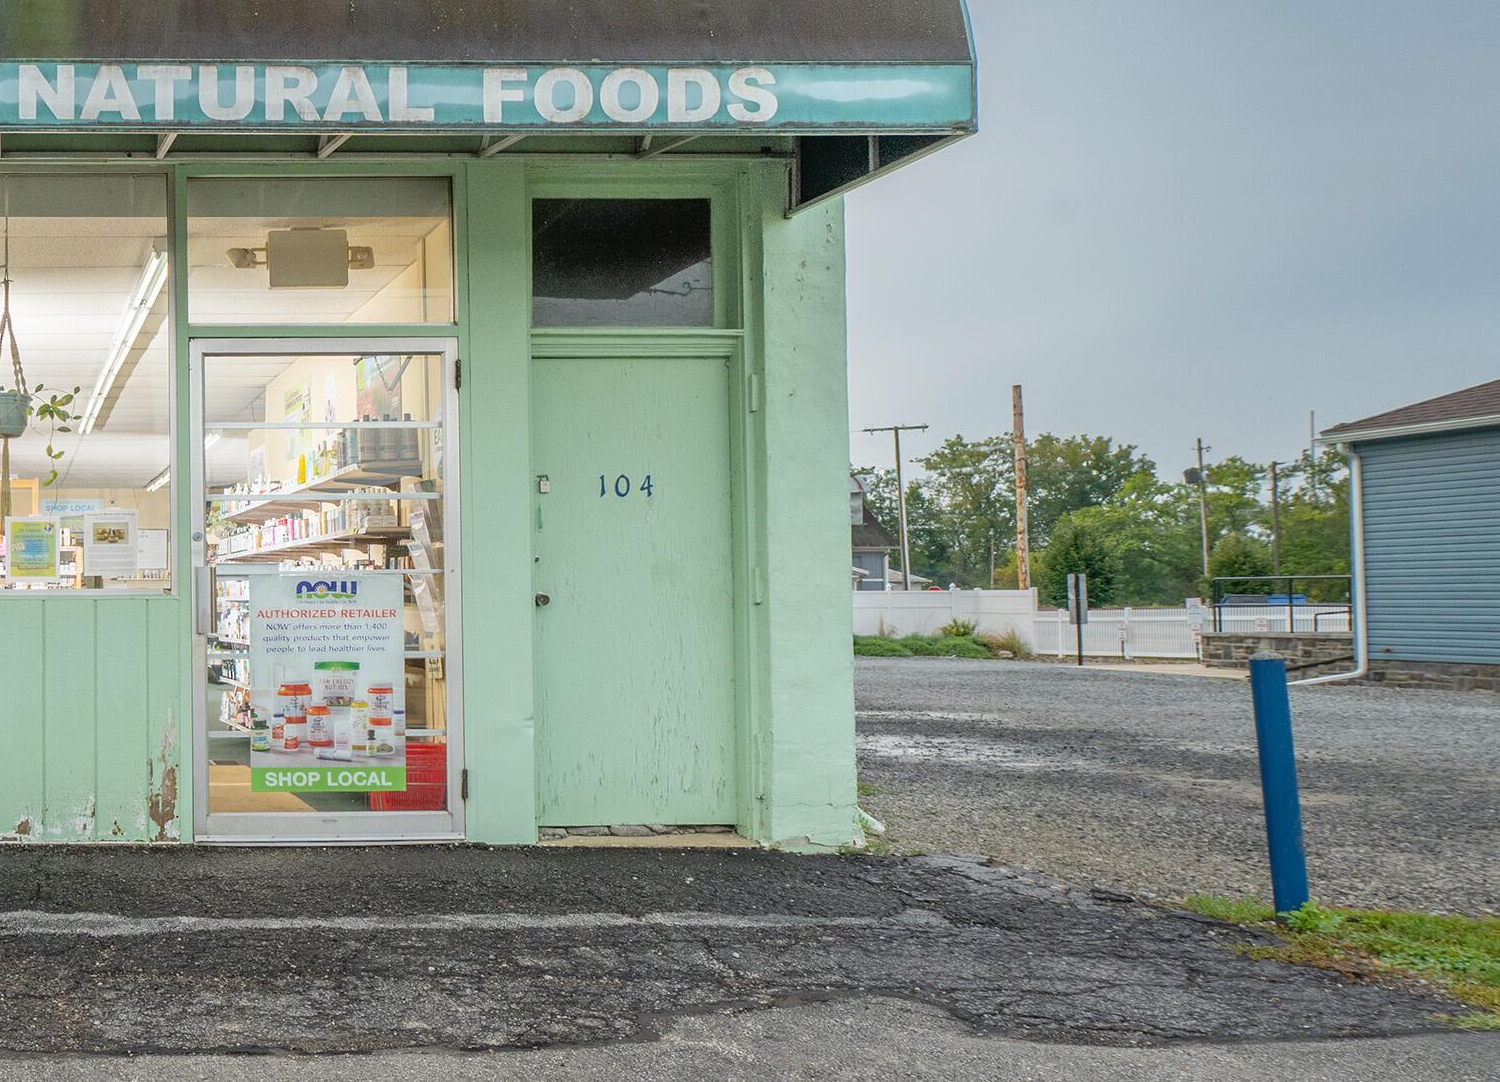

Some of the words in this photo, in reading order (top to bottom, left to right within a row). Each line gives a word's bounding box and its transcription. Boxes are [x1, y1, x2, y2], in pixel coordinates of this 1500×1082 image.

[18, 65, 435, 122] NATURAL
[482, 67, 778, 122] FOODS
[599, 474, 654, 498] 104
[257, 610, 336, 619] AUTHORIZED
[340, 609, 396, 618] RETAILER
[266, 645, 295, 653] people
[265, 772, 320, 786] SHOP
[327, 772, 392, 786] LOCAL
